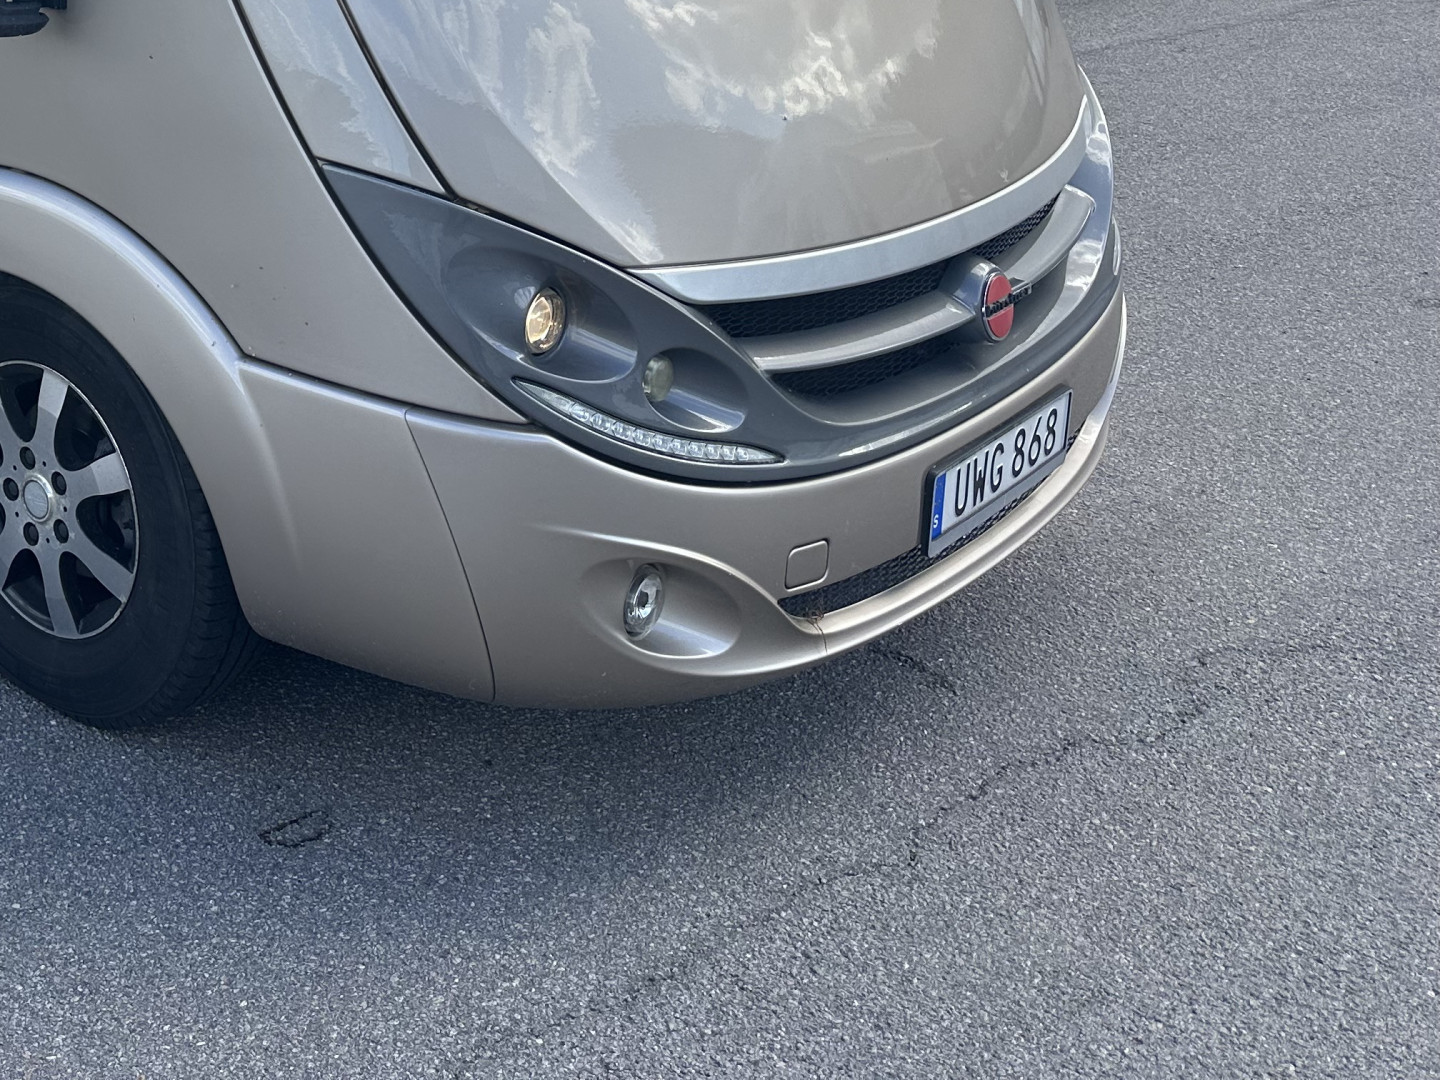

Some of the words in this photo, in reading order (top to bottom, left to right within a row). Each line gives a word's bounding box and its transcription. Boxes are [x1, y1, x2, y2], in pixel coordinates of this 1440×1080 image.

[954, 442, 1005, 517] UWG
[1011, 408, 1058, 478] 868
[932, 514, 939, 528] S
